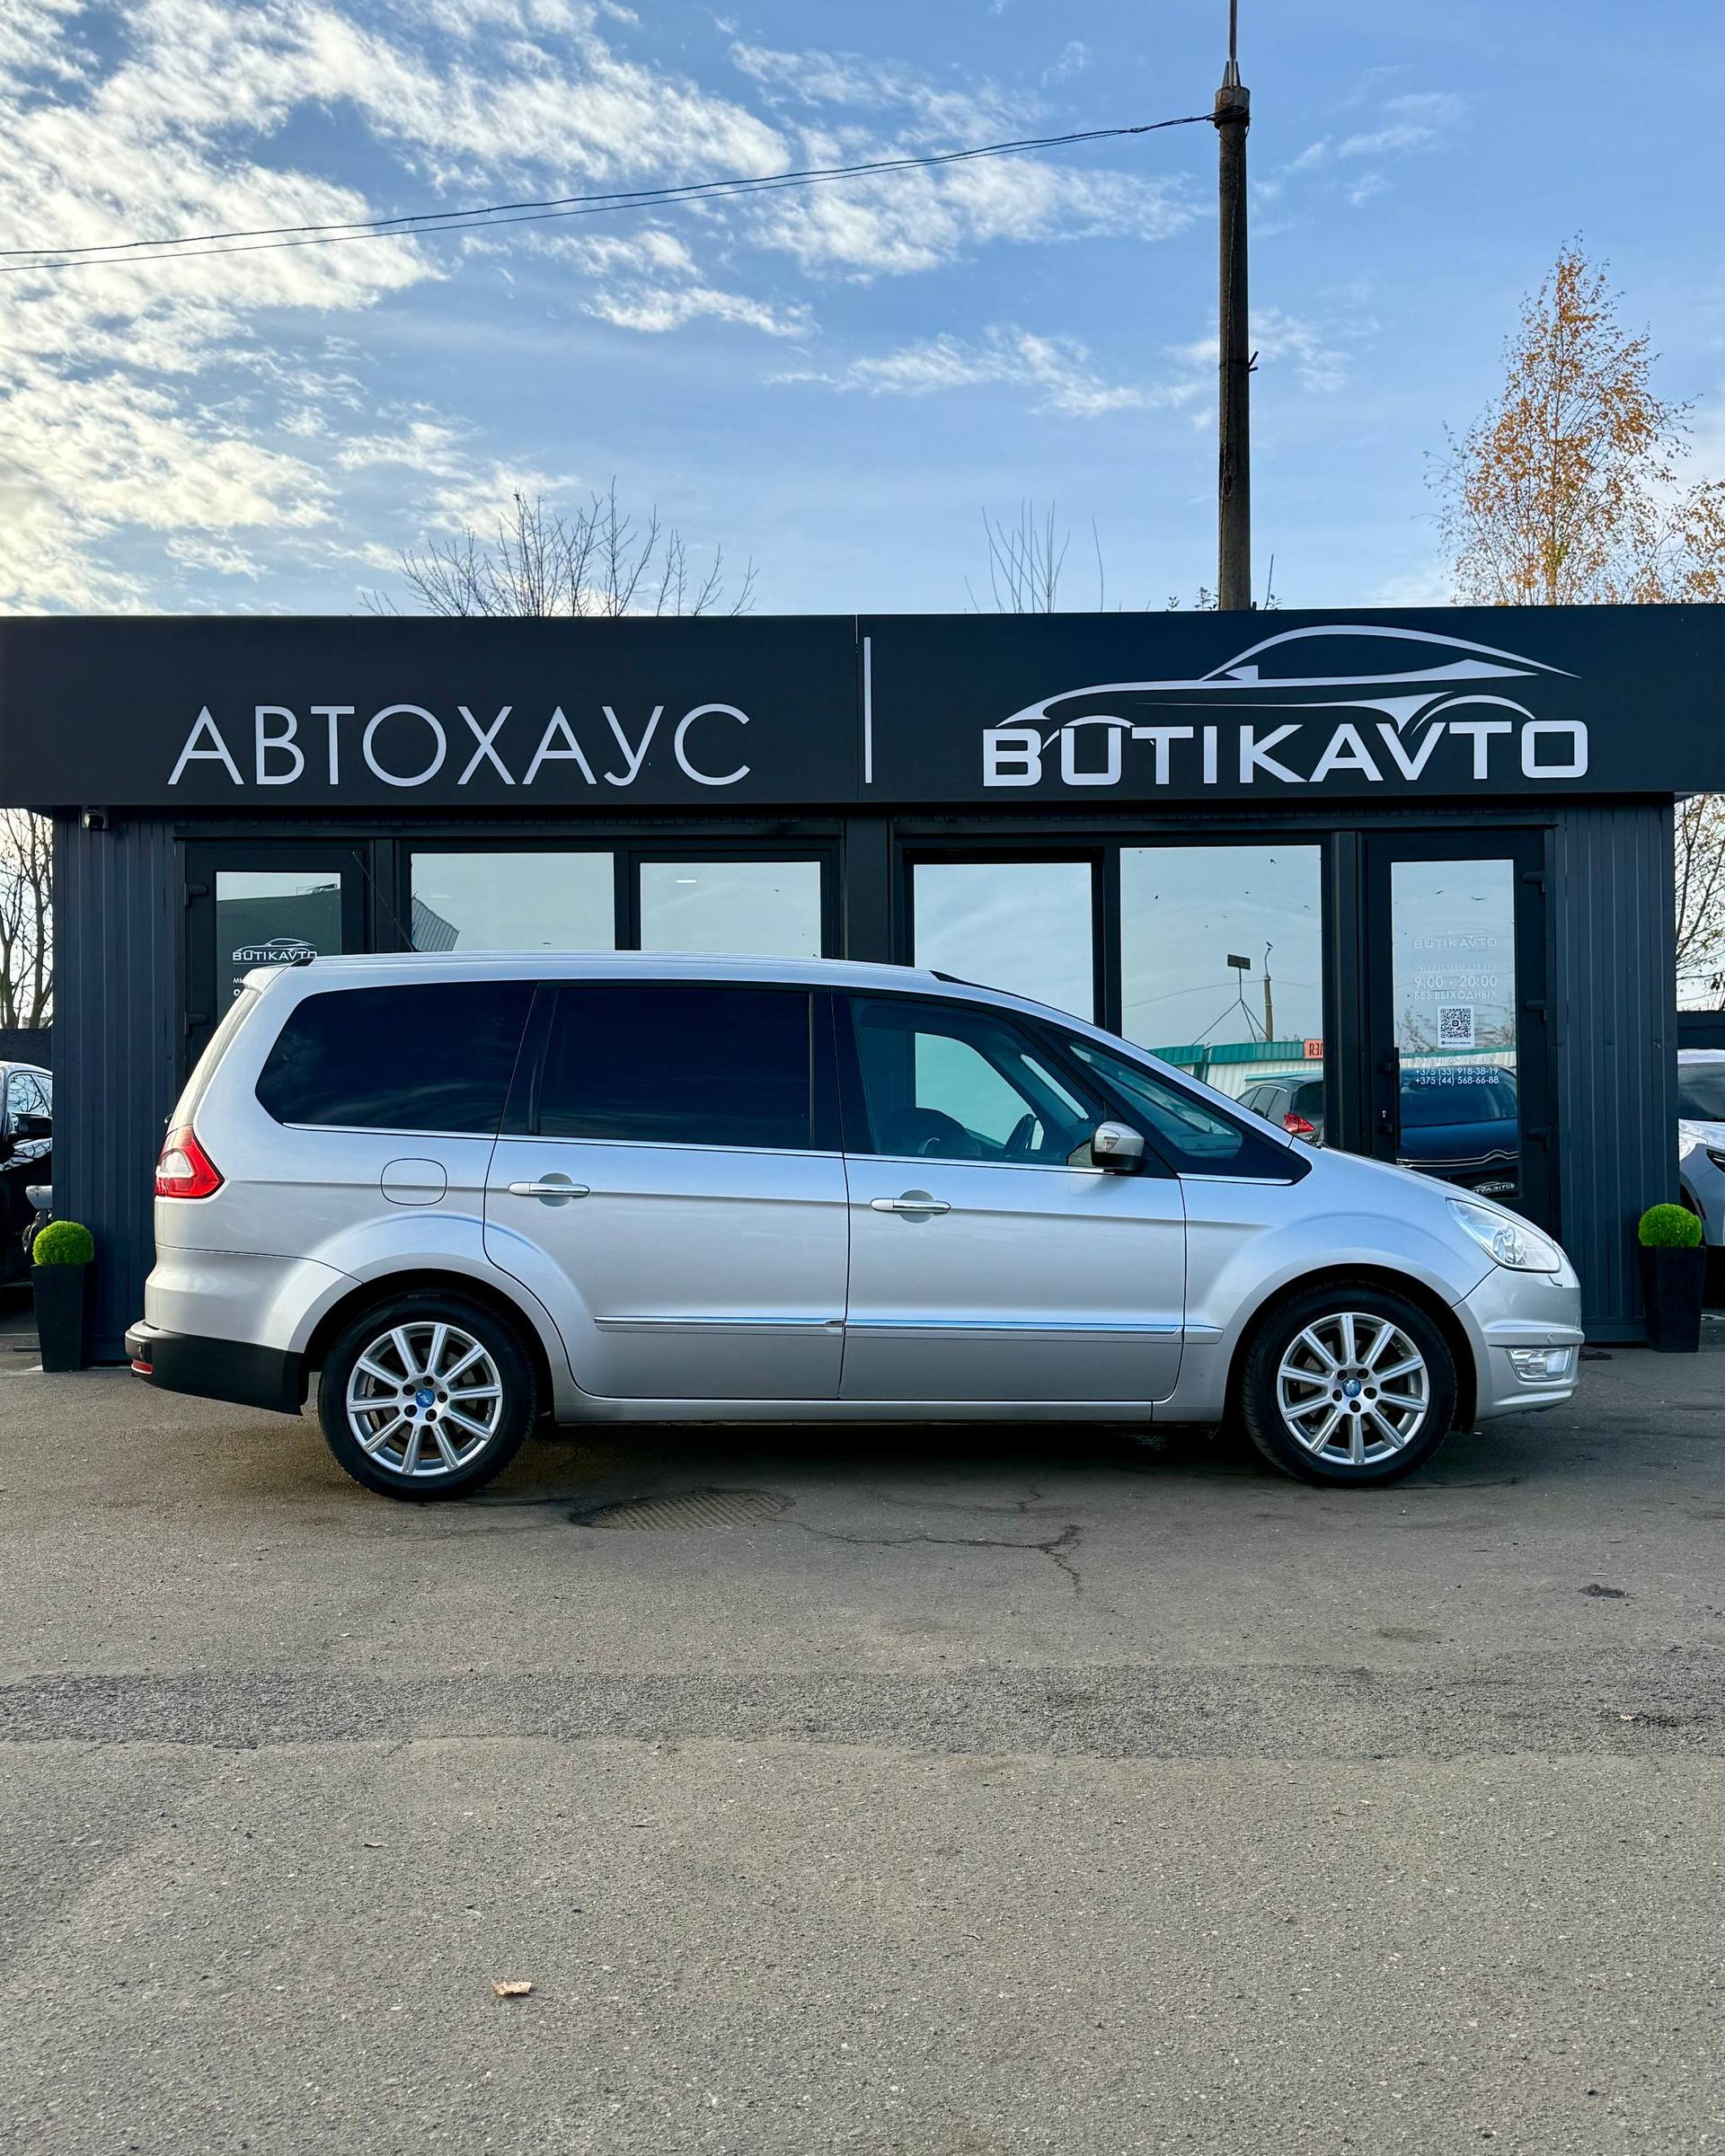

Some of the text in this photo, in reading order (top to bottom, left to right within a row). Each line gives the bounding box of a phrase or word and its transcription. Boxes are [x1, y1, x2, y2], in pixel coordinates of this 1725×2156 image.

[168, 703, 750, 787] АВТОХАУС
[983, 720, 1588, 786] BUTIKAVTO
[233, 950, 317, 960] BUTIKAVTO
[1459, 976, 1497, 987] 20:00
[1414, 990, 1497, 1000] БЕЗ ВЫХОДНЫХ
[1416, 1066, 1499, 1076] +375 (33) 918-38-19
[1416, 1075, 1499, 1086] +375 (44) 568-66-88
